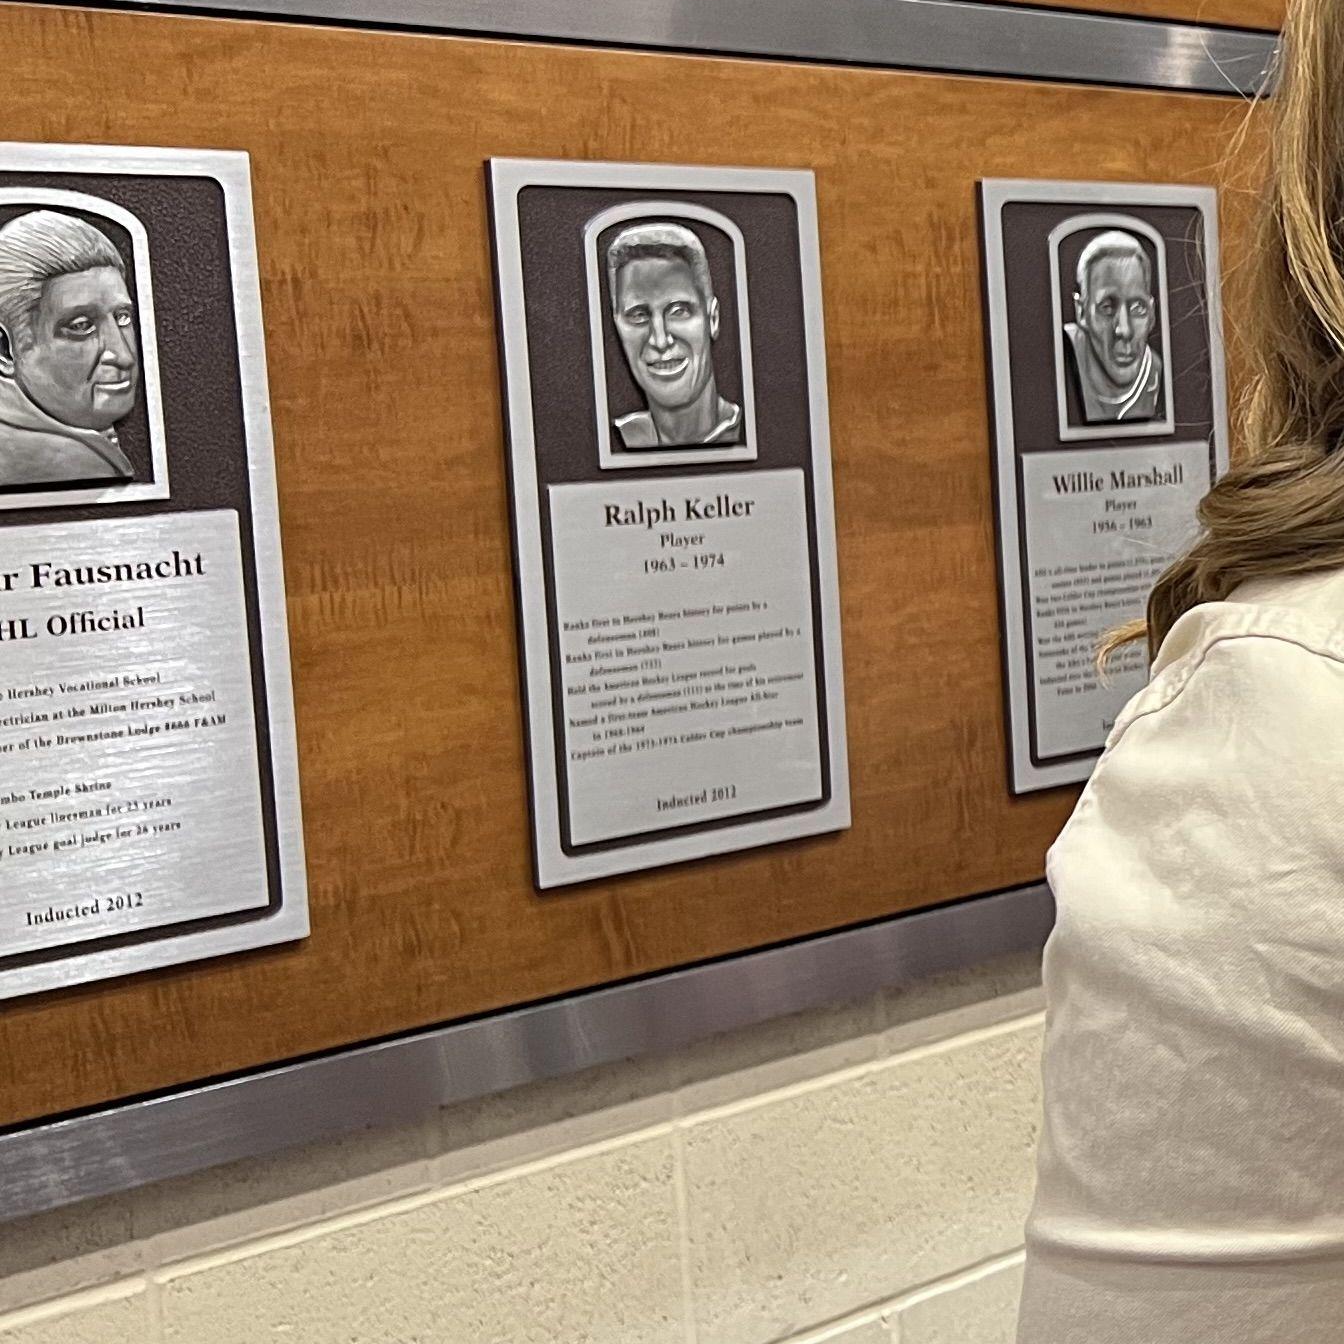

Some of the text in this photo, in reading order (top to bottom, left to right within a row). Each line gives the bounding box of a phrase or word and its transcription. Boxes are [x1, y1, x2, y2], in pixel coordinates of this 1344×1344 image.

[1052, 462, 1183, 494] Willie Marshall
[604, 495, 755, 530] Ralph Keller
[1105, 499, 1137, 513] Player
[660, 532, 705, 549] Player
[30, 551, 206, 588] Fausnacht
[643, 557, 676, 575] 1963
[693, 553, 725, 570] 1974
[47, 607, 145, 637] Official
[8, 686, 54, 700] Hershey
[59, 676, 119, 694] Vocational
[52, 709, 63, 721] at
[68, 706, 86, 719] the
[90, 702, 127, 715] Milton
[130, 698, 174, 711] Hershey
[179, 690, 216, 706] School
[18, 738, 30, 751] of
[34, 735, 52, 748] the
[28, 786, 71, 802] Temple
[656, 789, 707, 812] Inducted
[6, 816, 47, 831] League
[9, 840, 49, 856] League
[25, 891, 144, 927] Inducted 2012
